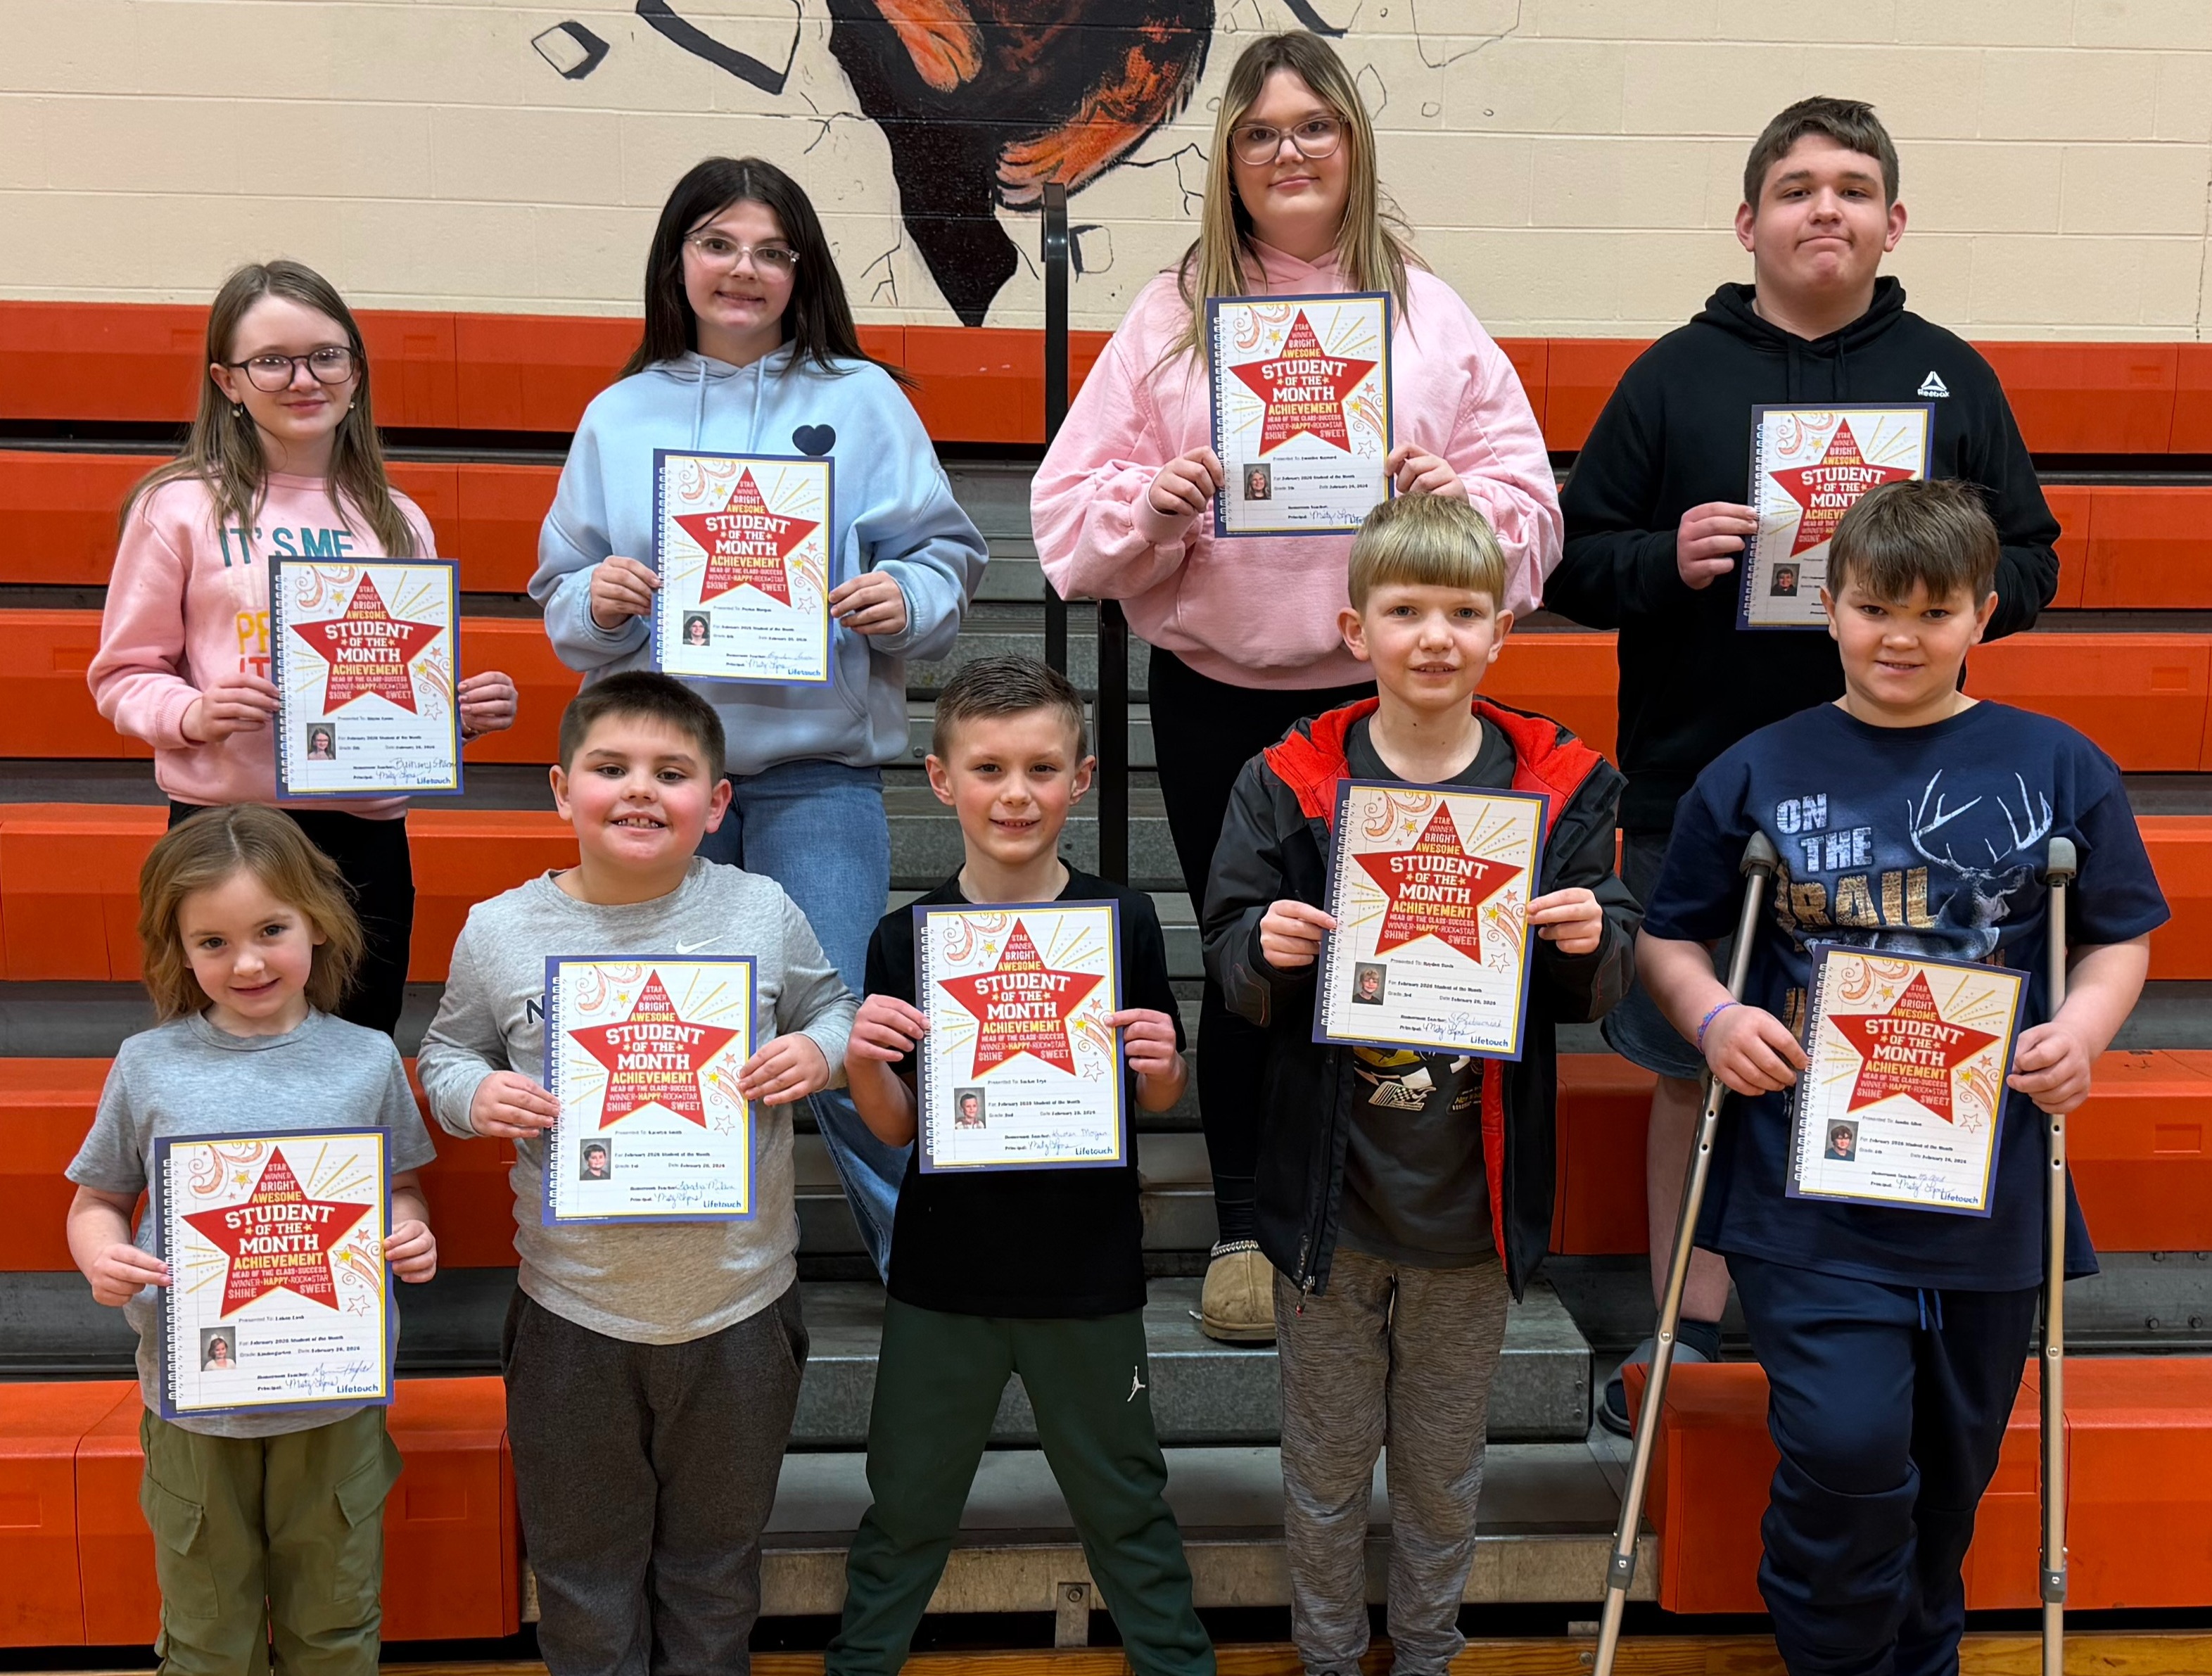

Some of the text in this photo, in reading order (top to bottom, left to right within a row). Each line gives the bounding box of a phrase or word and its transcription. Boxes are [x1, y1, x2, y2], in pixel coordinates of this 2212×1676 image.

[1288, 339, 1316, 348] BRIGHT
[1282, 348, 1321, 358] AWESOME
[1261, 360, 1347, 380] STUDENT
[1285, 376, 1322, 386] OF THE
[1273, 386, 1335, 402] MONTH
[1269, 402, 1339, 415] ACHIEVEMENT
[1801, 467, 1886, 485] STUDENT
[1824, 483, 1860, 492] OF THE
[734, 495, 761, 504] BRIGHT
[1810, 493, 1863, 507] MONT
[727, 504, 765, 514] AWESOME
[706, 515, 791, 534] STUDENT
[728, 530, 765, 540] OF THE
[716, 540, 777, 556] MONTH
[711, 555, 781, 569] ACHIEVEMENT
[353, 601, 381, 609] BRIGHT
[347, 611, 386, 619] AWESOME
[325, 621, 413, 640] STUDENT
[350, 637, 388, 647] OF THE
[336, 648, 400, 663] MONTH
[332, 664, 405, 675] ACHIEVEMENT
[1776, 793, 1828, 834] ON
[1434, 816, 1450, 825] STAR
[1424, 832, 1456, 844] BRIGHT
[1416, 842, 1461, 855] AWESOME
[1800, 827, 1873, 872] THE
[1390, 855, 1489, 880] STUDENT
[1415, 872, 1458, 886] OF THE
[1399, 882, 1471, 905] MONTH
[1392, 900, 1473, 919] ACHIEVEMENT
[1384, 929, 1410, 941] SHINE
[1448, 934, 1477, 946] SWEET
[1005, 951, 1036, 960] BRIGHT
[998, 961, 1041, 971] AWESOME
[974, 973, 1071, 995] STUDENT
[1911, 984, 1928, 992] STAR
[1000, 991, 1043, 1002] OF THE
[639, 1003, 670, 1011] BRIGHT
[1901, 998, 1933, 1010] BRIGHT
[631, 1012, 675, 1022] AWESOME
[987, 1002, 1057, 1020] MONTH
[1891, 1008, 1936, 1021] AWESOME
[982, 1020, 1062, 1034] ACHIEVEMENT
[1866, 1019, 1964, 1044] STUDENT
[606, 1024, 705, 1045] STUDENT
[633, 1042, 675, 1052] OF THE
[1470, 1036, 1508, 1048] Lifetouch
[1889, 1035, 1933, 1049] OF THE
[978, 1051, 1003, 1061] SHINE
[1041, 1049, 1069, 1059] SWEET
[1872, 1043, 1945, 1067] MONTH
[618, 1054, 689, 1069] MONTH
[1864, 1060, 1947, 1081] ACHIEVEMENT
[612, 1072, 694, 1084] ACHIEVEMENT
[1856, 1087, 1882, 1099] SHINE
[606, 1102, 632, 1111] SHINE
[671, 1102, 700, 1110] SWEET
[1920, 1095, 1950, 1106] SWEET
[1076, 1147, 1112, 1156] Lifetouch
[268, 1163, 286, 1172] STAR
[260, 1181, 295, 1192] BRIGHT
[253, 1191, 302, 1203] AWESOME
[1940, 1192, 1978, 1205] Lifetouch
[704, 1200, 742, 1209] Lifetouch
[225, 1205, 335, 1229] STUDENT
[255, 1222, 303, 1236] OF THE
[239, 1233, 319, 1255] MONTH
[234, 1252, 324, 1270] ACHIEVEMENT
[229, 1288, 257, 1299] SHINE
[300, 1283, 332, 1294] SWEET
[337, 1383, 379, 1394] Lifetouch
